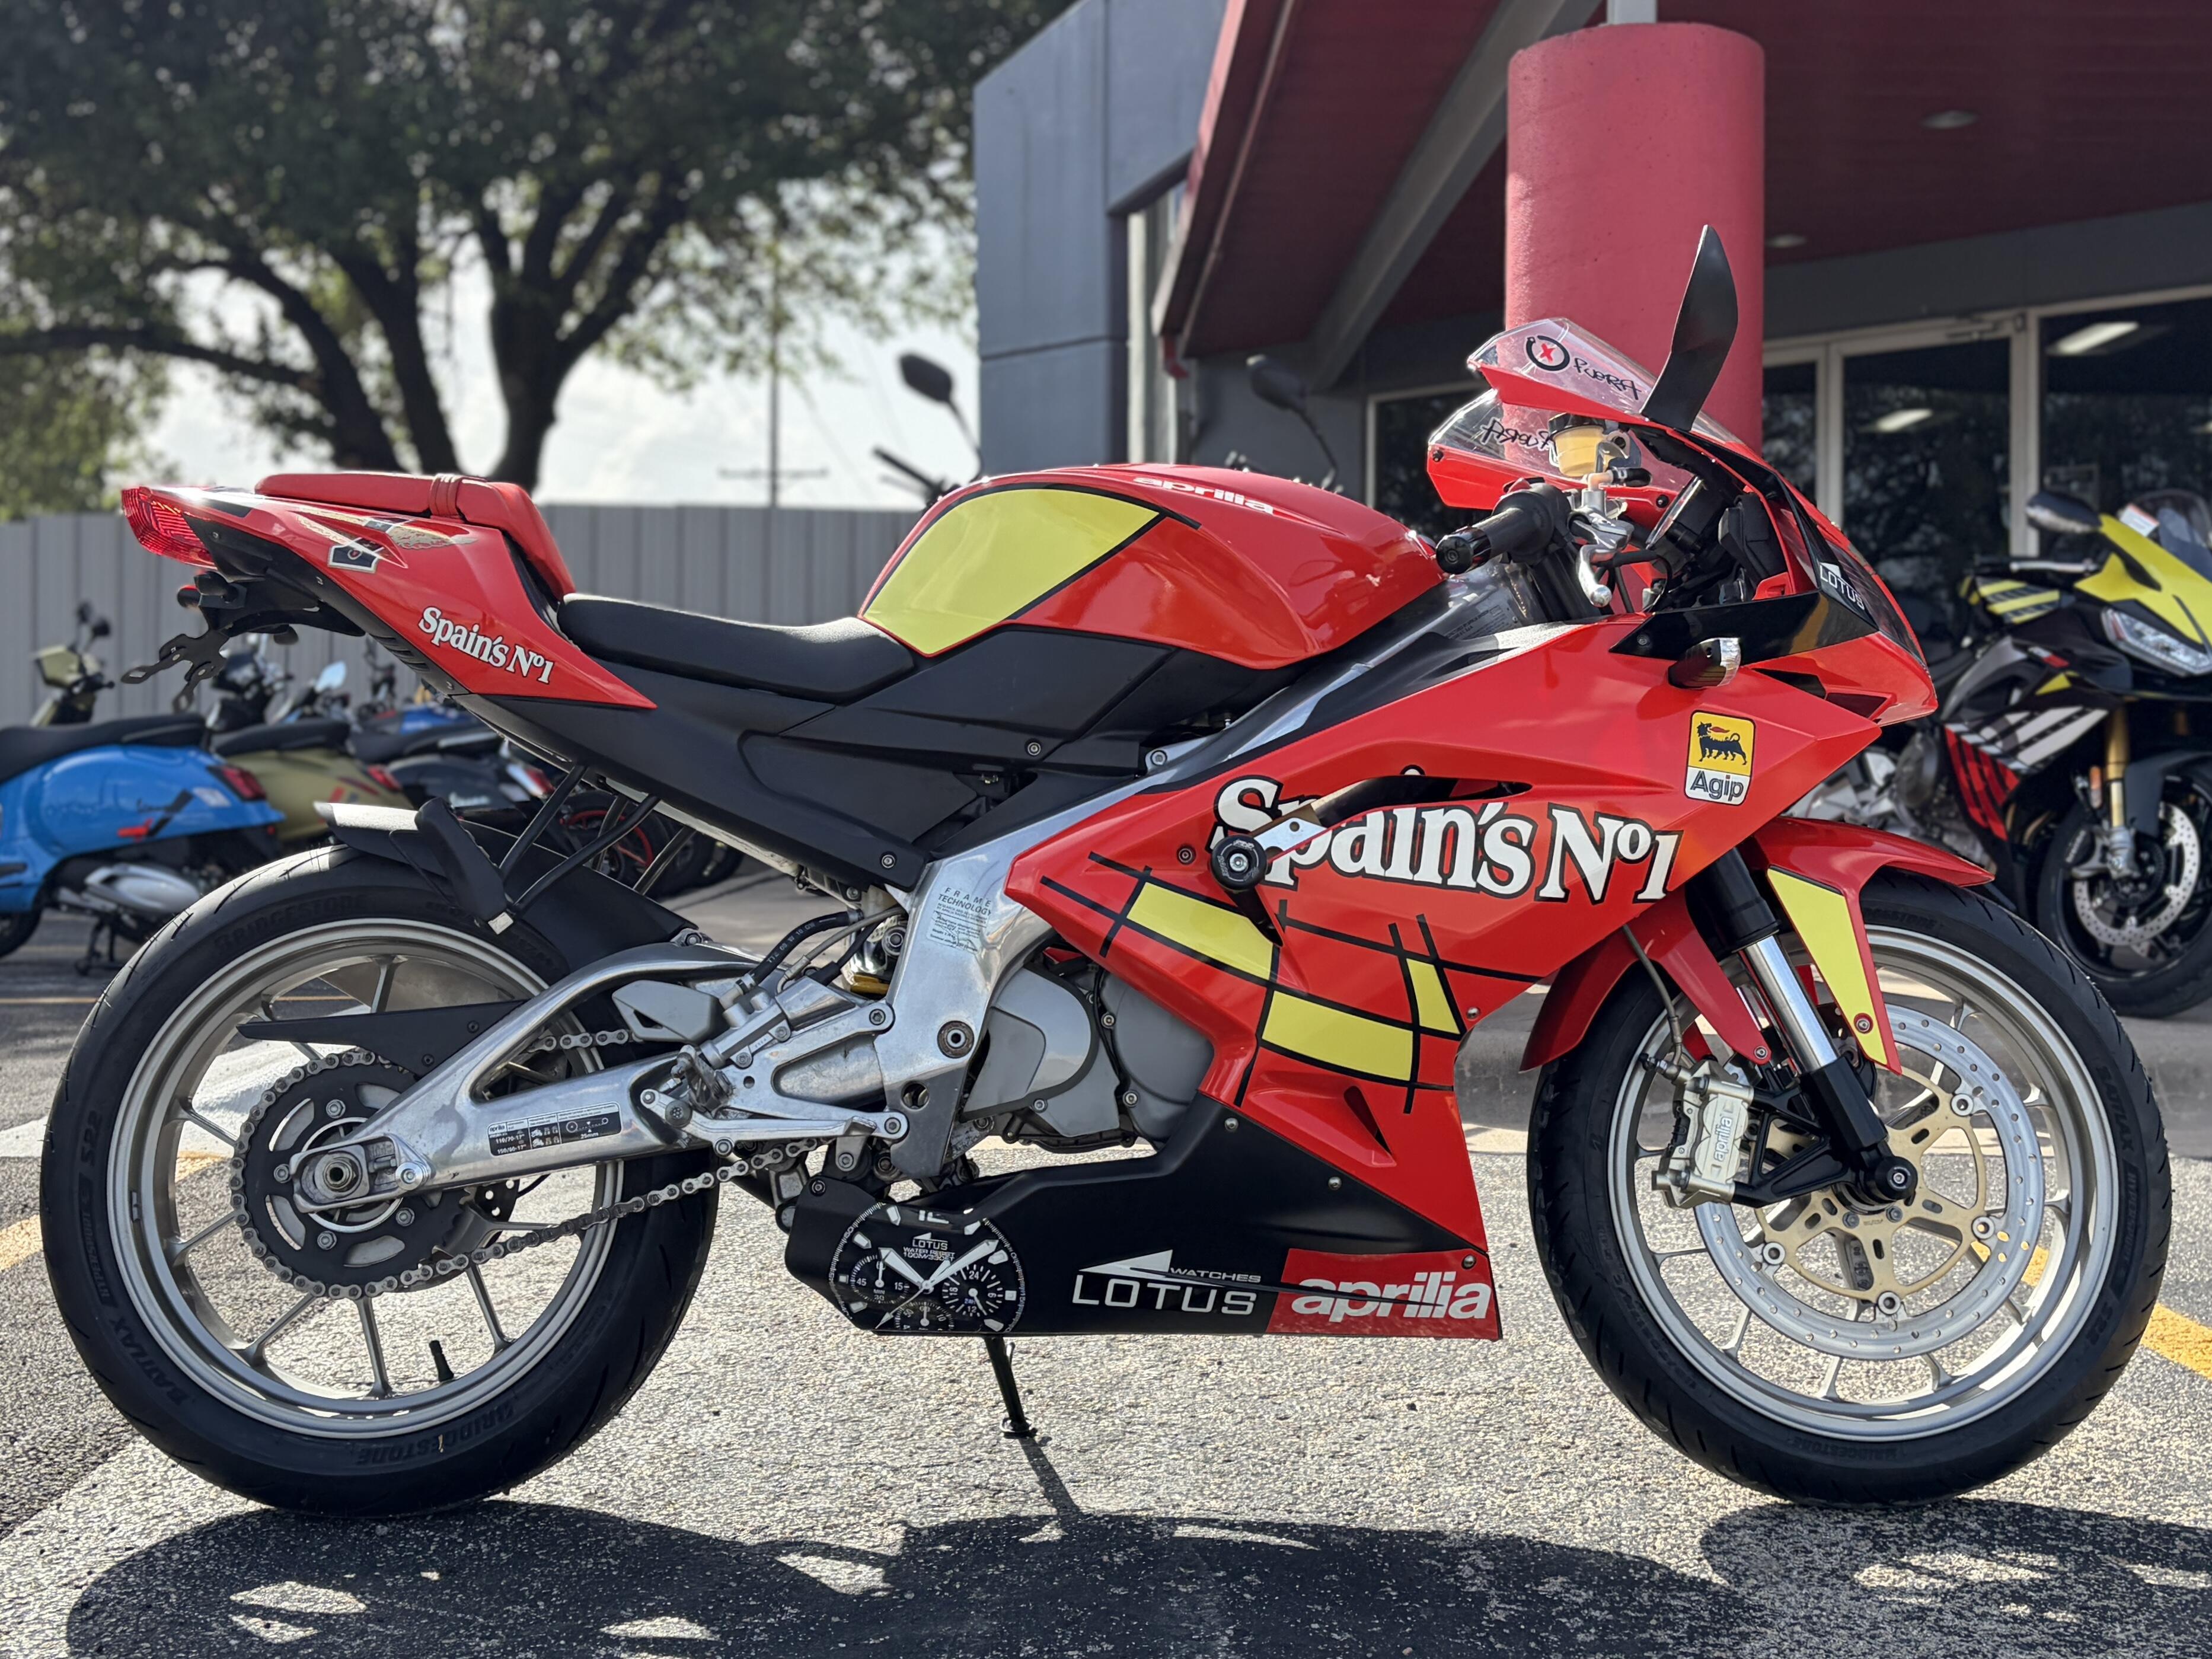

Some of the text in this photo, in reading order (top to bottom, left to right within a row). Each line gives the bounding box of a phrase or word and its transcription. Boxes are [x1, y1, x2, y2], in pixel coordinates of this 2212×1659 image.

[1133, 477, 1274, 515] aprilia
[1820, 564, 1865, 611] LOTUS
[418, 607, 510, 668] Spain's
[1690, 770, 1744, 802] Agip
[938, 894, 992, 916] TECHNOLOGY
[1713, 1115, 1732, 1162] aprilia
[2096, 1066, 2135, 1151] BATTLAX
[2123, 1172, 2137, 1265] HYPERSPORT
[81, 1211, 111, 1297] HYPERSPORT
[912, 1239, 948, 1250] LOTUS
[856, 1278, 867, 1286] 45
[894, 1282, 904, 1290] 15
[949, 1287, 959, 1296] 18
[969, 1270, 979, 1280] 24
[1170, 1267, 1261, 1282] WATCHES
[1073, 1274, 1257, 1316] LOTUS
[1291, 1271, 1492, 1323] aprilia
[108, 1316, 191, 1406] BATTLAX
